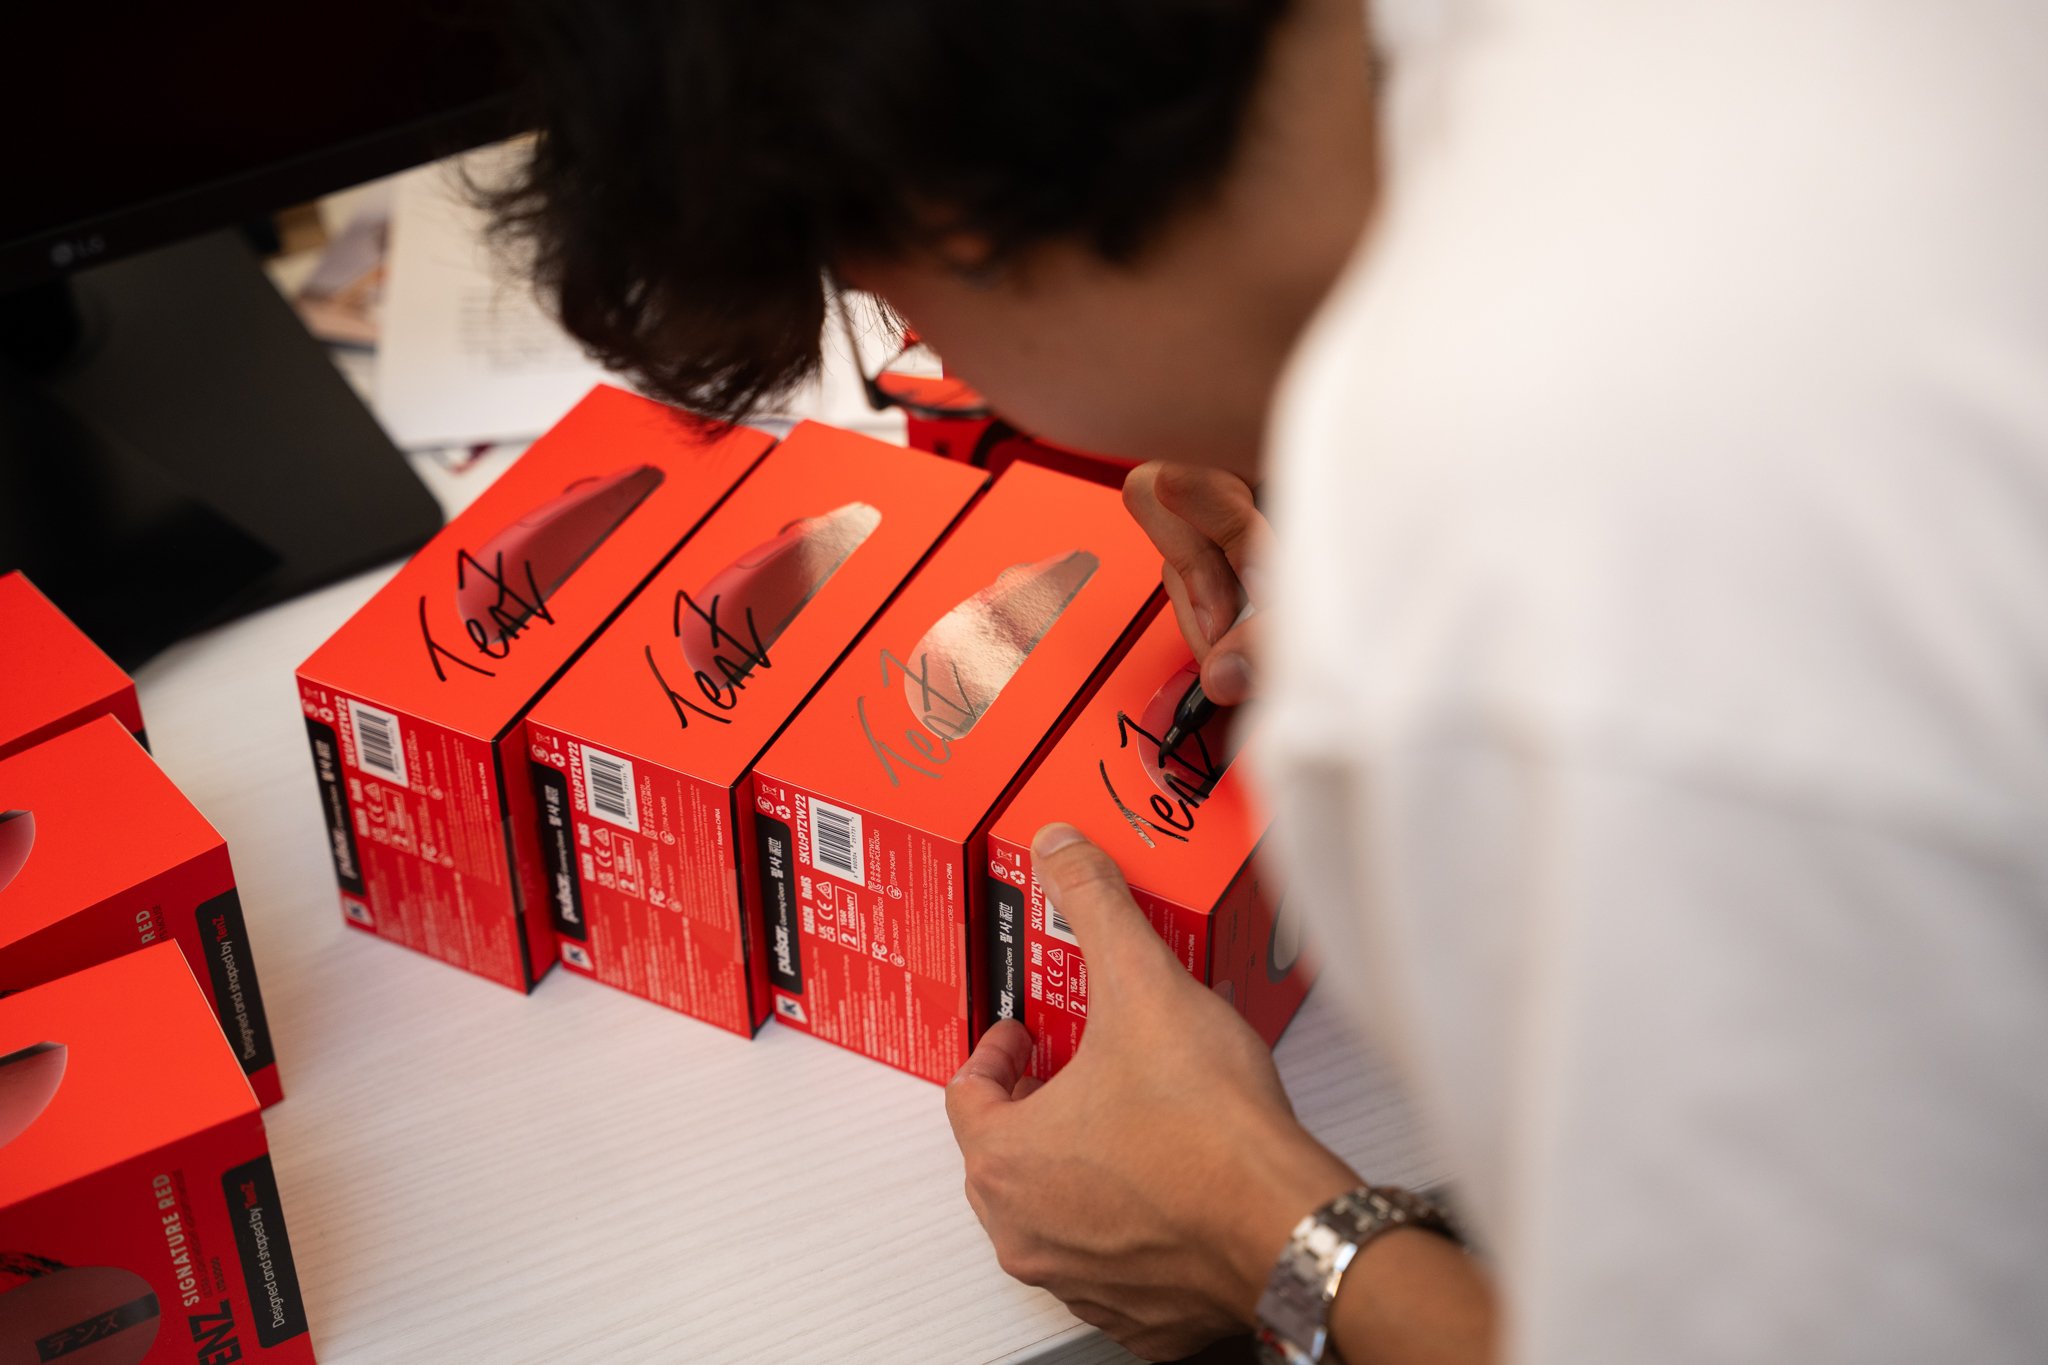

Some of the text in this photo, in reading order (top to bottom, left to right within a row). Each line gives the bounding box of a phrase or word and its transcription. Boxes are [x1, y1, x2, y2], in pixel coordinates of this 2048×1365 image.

[567, 741, 587, 812] SKU:PTZW22
[795, 793, 810, 865] SKU:PTZW22
[816, 899, 834, 921] CE
[846, 894, 856, 929] WARRANTY
[1031, 866, 1043, 931] SKU:PTZW
[135, 910, 156, 945] RED
[211, 914, 228, 943] TenZ
[839, 909, 848, 926] YEAR
[841, 933, 857, 946] 2
[1031, 941, 1043, 966] RoHS
[1005, 947, 1013, 966] Gears
[221, 954, 240, 992] shaped
[1005, 965, 1015, 991] Gaming
[1031, 971, 1043, 1001] REACH
[1046, 966, 1064, 987] CE
[1070, 976, 1078, 993] YEAR
[1078, 962, 1087, 997] WARRANTY
[1046, 989, 1055, 1006] UK
[1055, 993, 1065, 1009] CA
[1070, 1000, 1087, 1014] 2
[235, 1012, 257, 1061] Designed
[151, 1171, 175, 1210] RED
[249, 1206, 263, 1224] by
[249, 1220, 270, 1261] shaped
[162, 1210, 200, 1308] SIGNATURE
[259, 1259, 276, 1281] and
[264, 1277, 286, 1329] Designed
